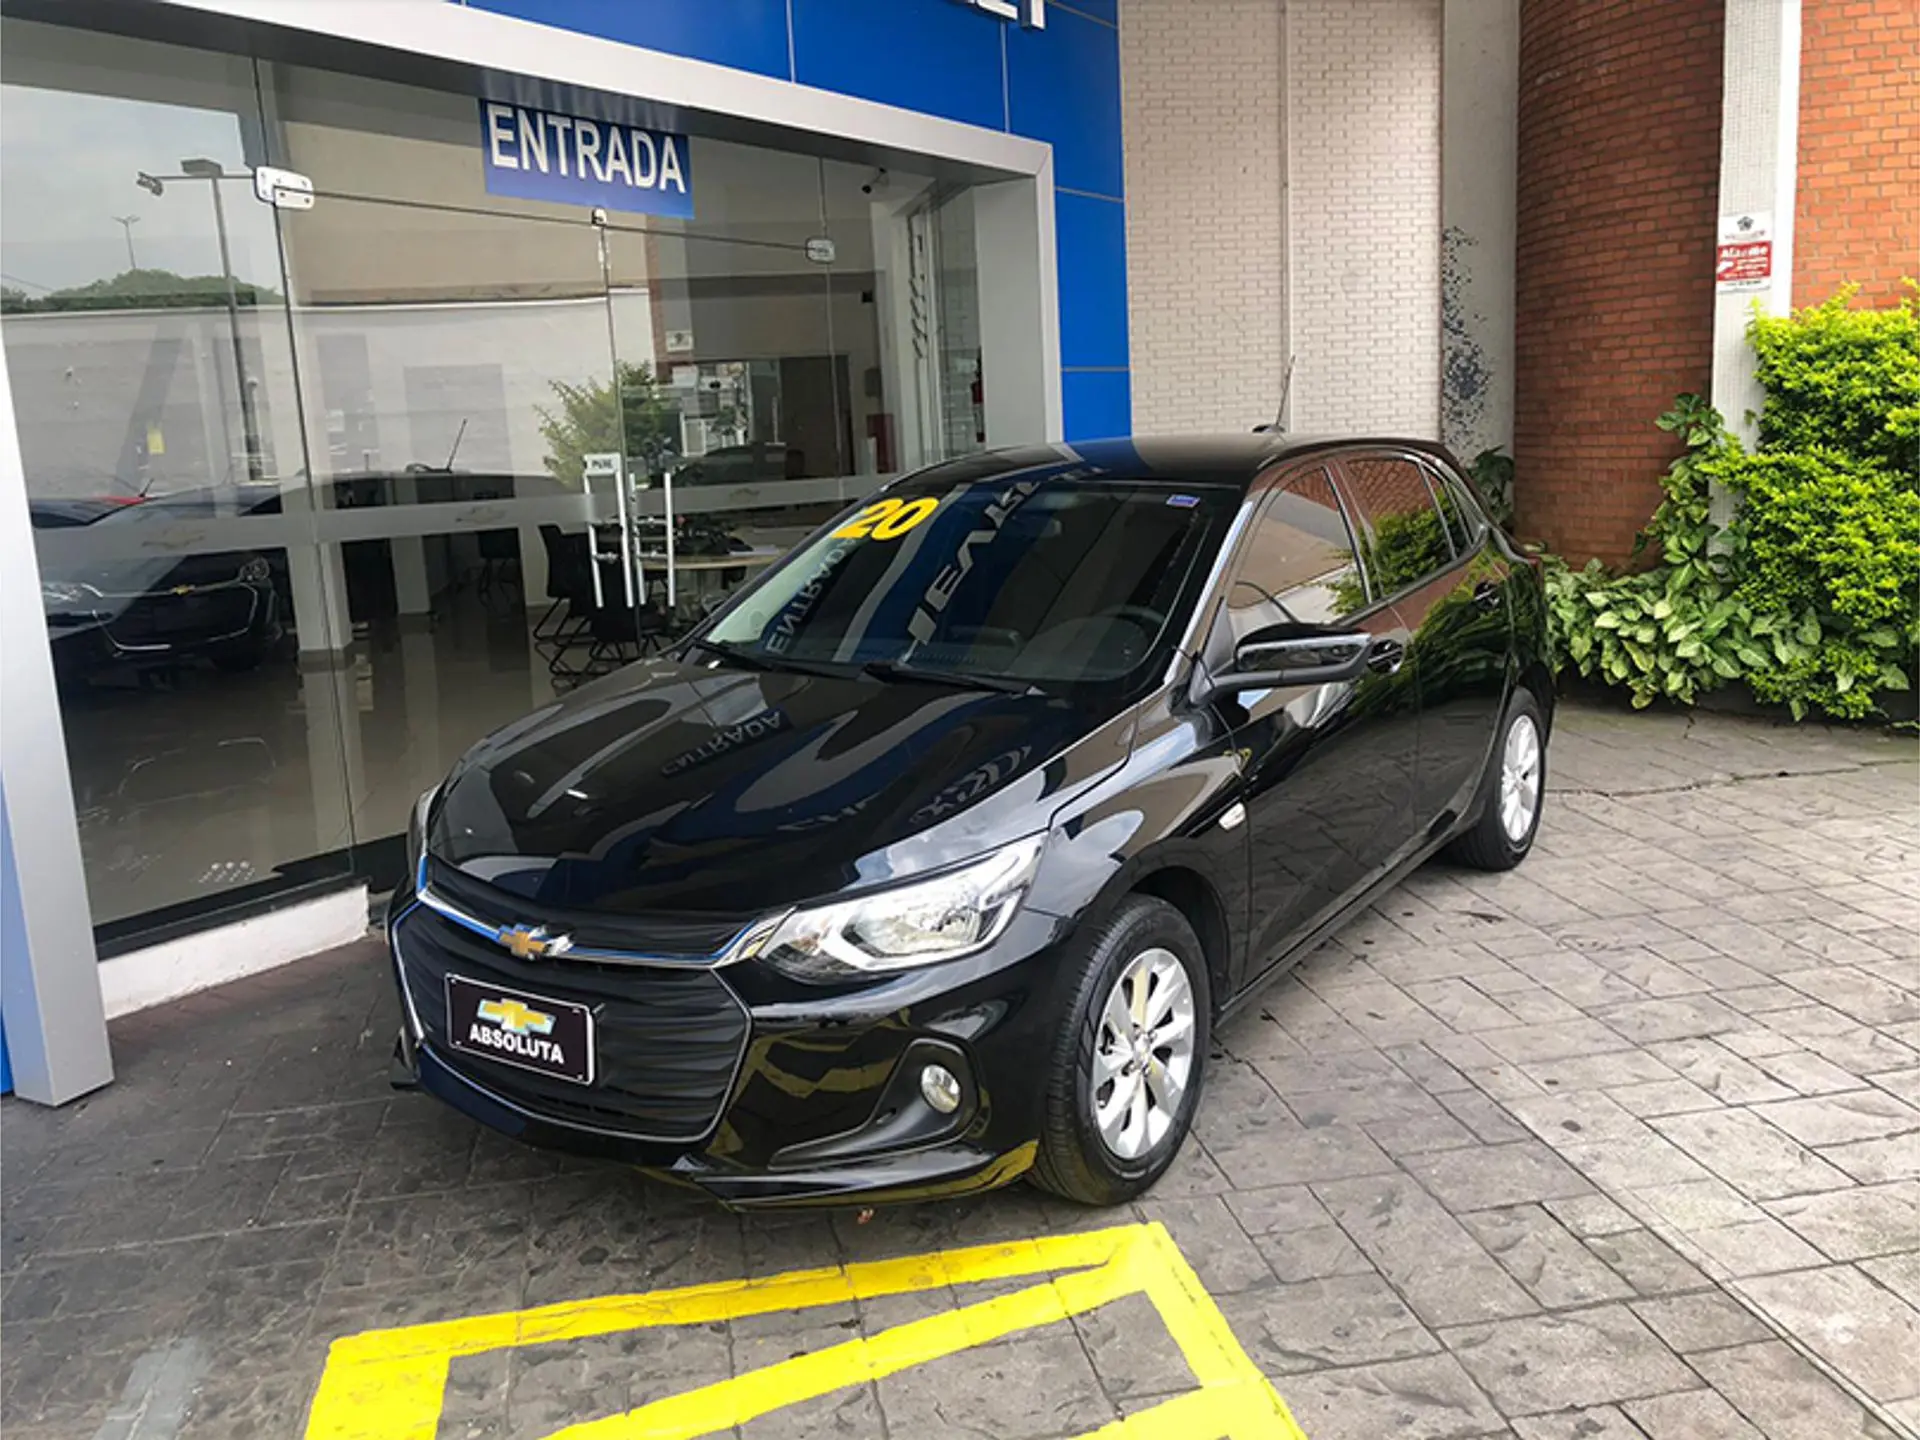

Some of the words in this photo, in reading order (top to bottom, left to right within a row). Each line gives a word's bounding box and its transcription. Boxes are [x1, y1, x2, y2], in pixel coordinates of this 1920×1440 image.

[487, 102, 687, 194] ENTRADA
[831, 498, 939, 540] 20
[469, 1023, 565, 1065] ABSOLUTA
